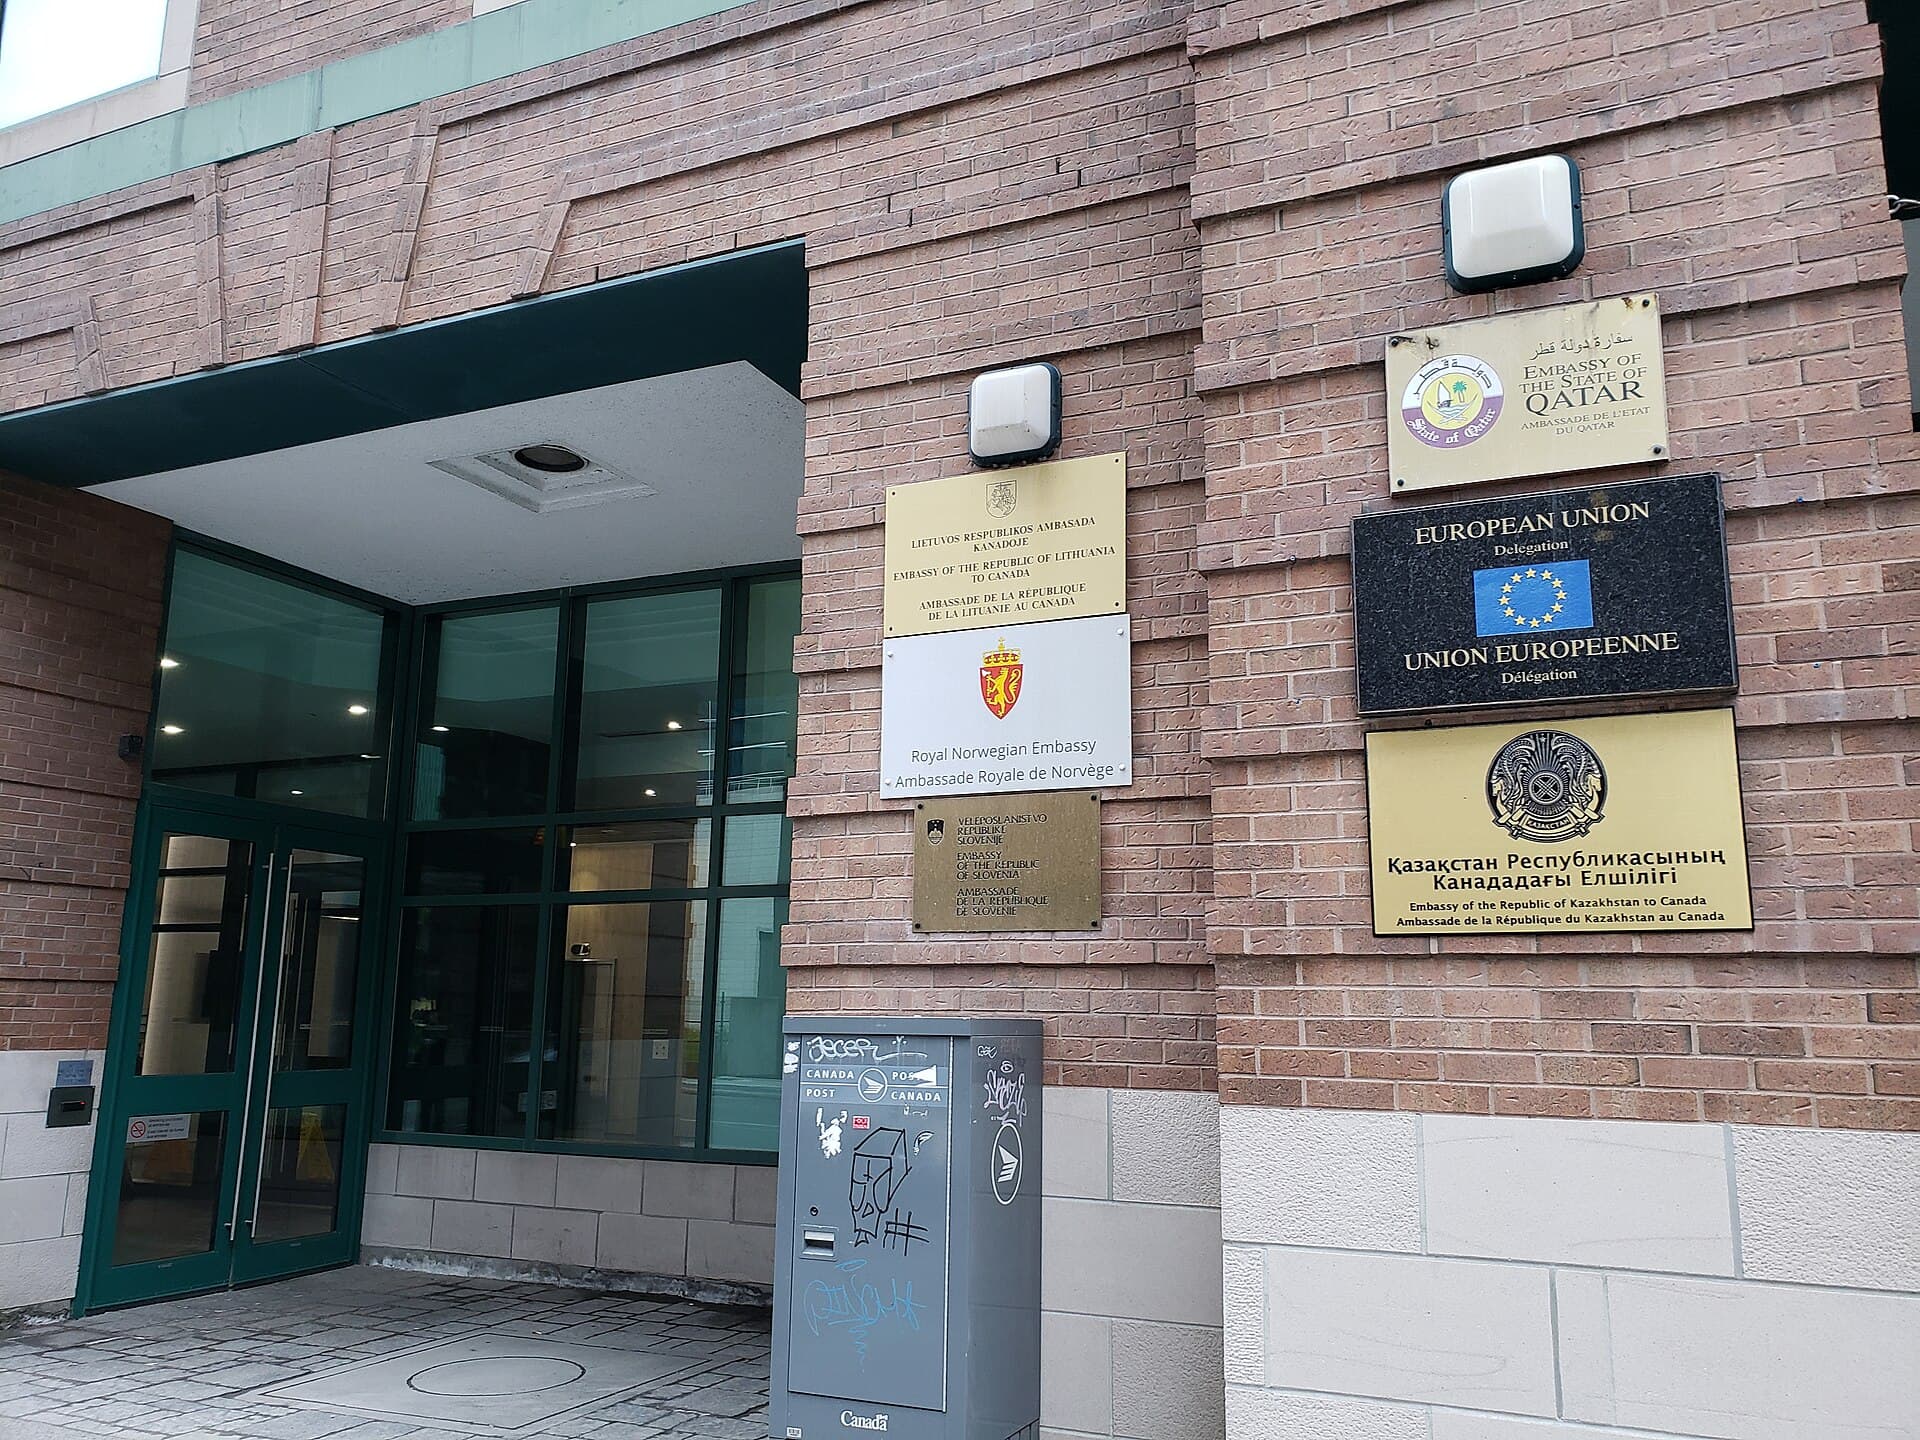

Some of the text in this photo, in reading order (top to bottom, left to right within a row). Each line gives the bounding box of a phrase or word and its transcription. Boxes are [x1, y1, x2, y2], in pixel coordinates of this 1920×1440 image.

[1529, 342, 1555, 360] قطر
[1617, 353, 1641, 366] OF
[1519, 367, 1647, 394] THE STATE OF
[1526, 381, 1646, 416] QATAR
[1407, 408, 1496, 444] State of Qatar
[1521, 406, 1651, 430] AMBASSADE DE L'ETAT
[1556, 421, 1615, 435] DU QATAR
[1415, 502, 1651, 545] EUROPEAN UNION
[911, 517, 1095, 549] LIETUVOS RESPUBLIKOS AMBASADA
[973, 537, 1029, 552] KANADOJE
[1494, 538, 1569, 557] Delegation
[893, 546, 1115, 581] EMBASSY OF THE REPUBLIC OF LITHUANIA
[972, 569, 1030, 584] TO CANADA
[919, 595, 980, 610] AMBASSADE
[984, 593, 998, 603] DE
[1001, 591, 1015, 601] LA
[928, 597, 1075, 621] DE LA LITUANIE AU CANADA
[1404, 632, 1680, 672] UNION EUROPEENNE
[1501, 668, 1577, 686] Délégation
[911, 740, 1097, 765] Royal Norwegian Embassy
[895, 763, 1114, 788] Ambassade Royale de Norvège
[957, 825, 1006, 835] REPUBLIKE
[957, 835, 1004, 845] SLOVENIJE
[957, 851, 1002, 860] EMBASSY
[957, 859, 1041, 870] OF THE REPUBLIC
[1388, 849, 1726, 874] Қазақстан Республикасының
[957, 870, 1020, 880] OF SLOVENIA
[1432, 867, 1677, 892] Канададағы Елшілігі
[957, 886, 1020, 896] AMBASSADE
[957, 897, 969, 906] DE
[972, 897, 986, 906] LA
[1409, 895, 1707, 914] Embassy of the Republic of Kazakhstan to Canada
[957, 906, 1017, 916] DE SLOVENIE
[1396, 910, 1725, 928] Ambassade de la République du Kazakhstan au Canada
[806, 1069, 854, 1080] CANADA
[806, 1088, 835, 1098] POST
[891, 1091, 941, 1102] CANADA
[841, 1410, 889, 1431] Canada
